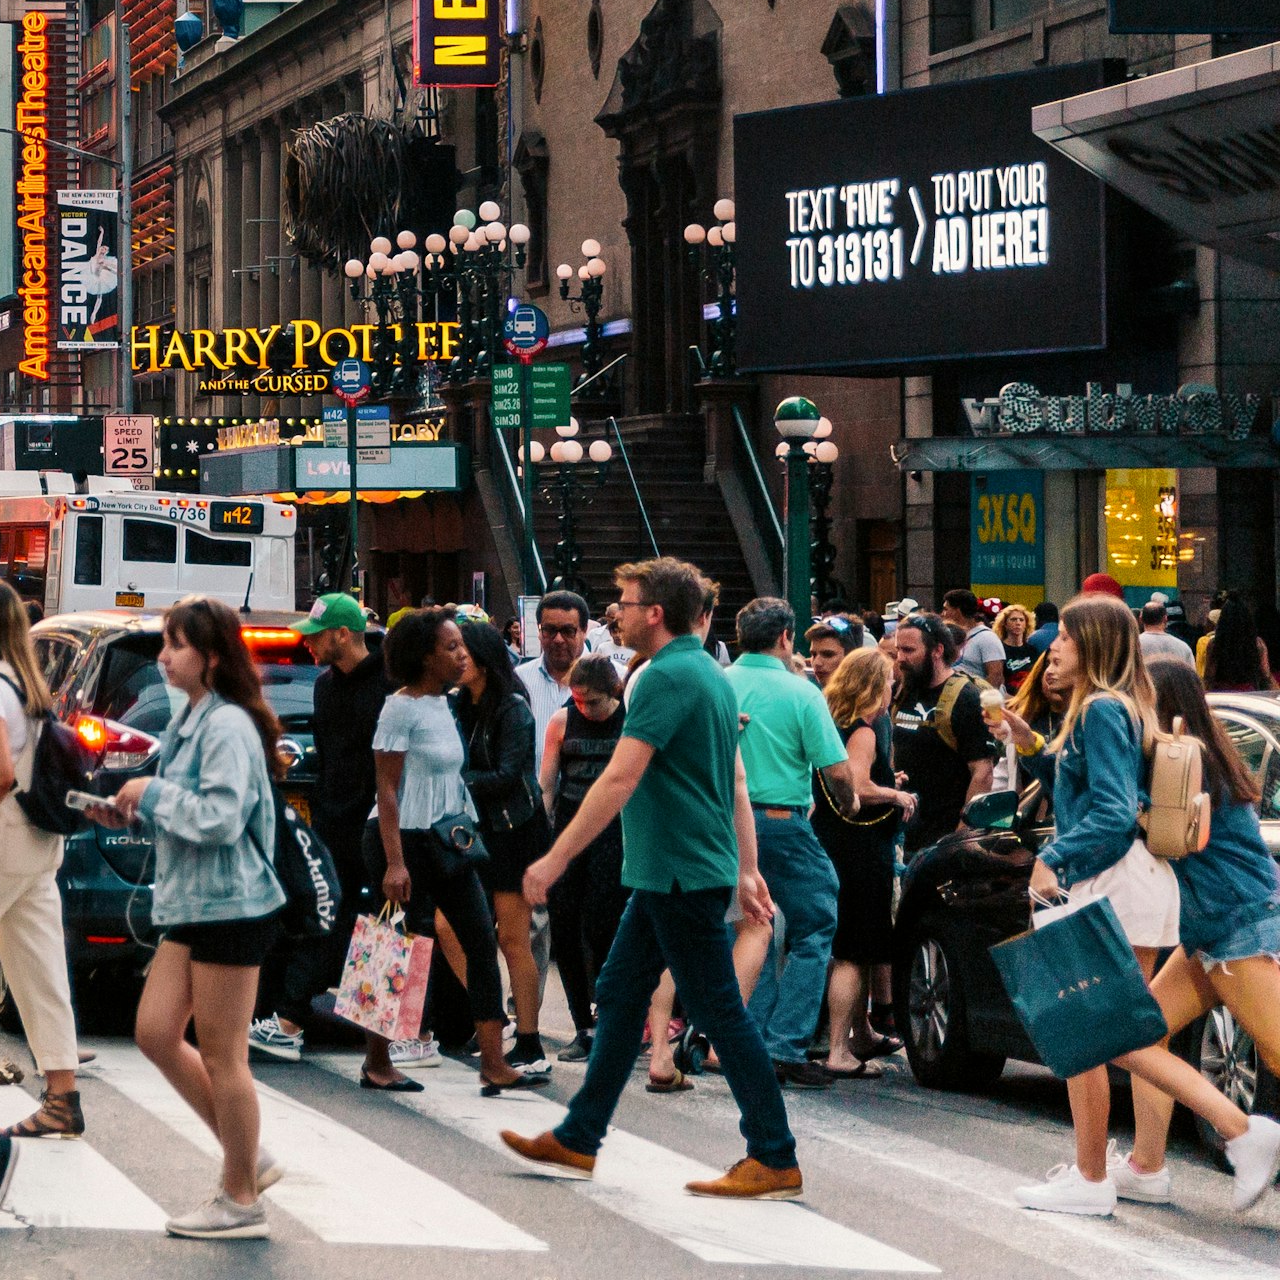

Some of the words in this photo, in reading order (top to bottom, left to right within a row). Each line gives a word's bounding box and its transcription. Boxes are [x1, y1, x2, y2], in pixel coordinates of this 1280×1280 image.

[931, 173, 956, 215] TO
[957, 169, 992, 212] PUT
[996, 161, 1047, 208] YOUR
[785, 186, 835, 233] TEXT
[932, 216, 968, 275] AD
[972, 206, 1049, 270] HERE!
[786, 237, 815, 288] TO
[817, 227, 903, 287] 313131
[61, 218, 88, 325] DANCE
[131, 324, 283, 371] HARRY
[507, 341, 515, 351] NO
[515, 341, 544, 354] STANDING
[493, 367, 513, 379] SIM8
[199, 380, 226, 392] AND
[228, 379, 250, 391] THE
[253, 374, 329, 393] CURSED
[494, 383, 519, 395] SIM22
[323, 409, 343, 420] M42
[495, 415, 521, 426] SIM30
[118, 419, 138, 427] CITY
[114, 428, 143, 437] SPEED
[116, 438, 140, 446] LIMIT
[111, 448, 148, 470] 25
[134, 503, 148, 512] City
[169, 507, 206, 521] 6736
[223, 507, 252, 524] M42
[977, 492, 1037, 545] 3XSQ
